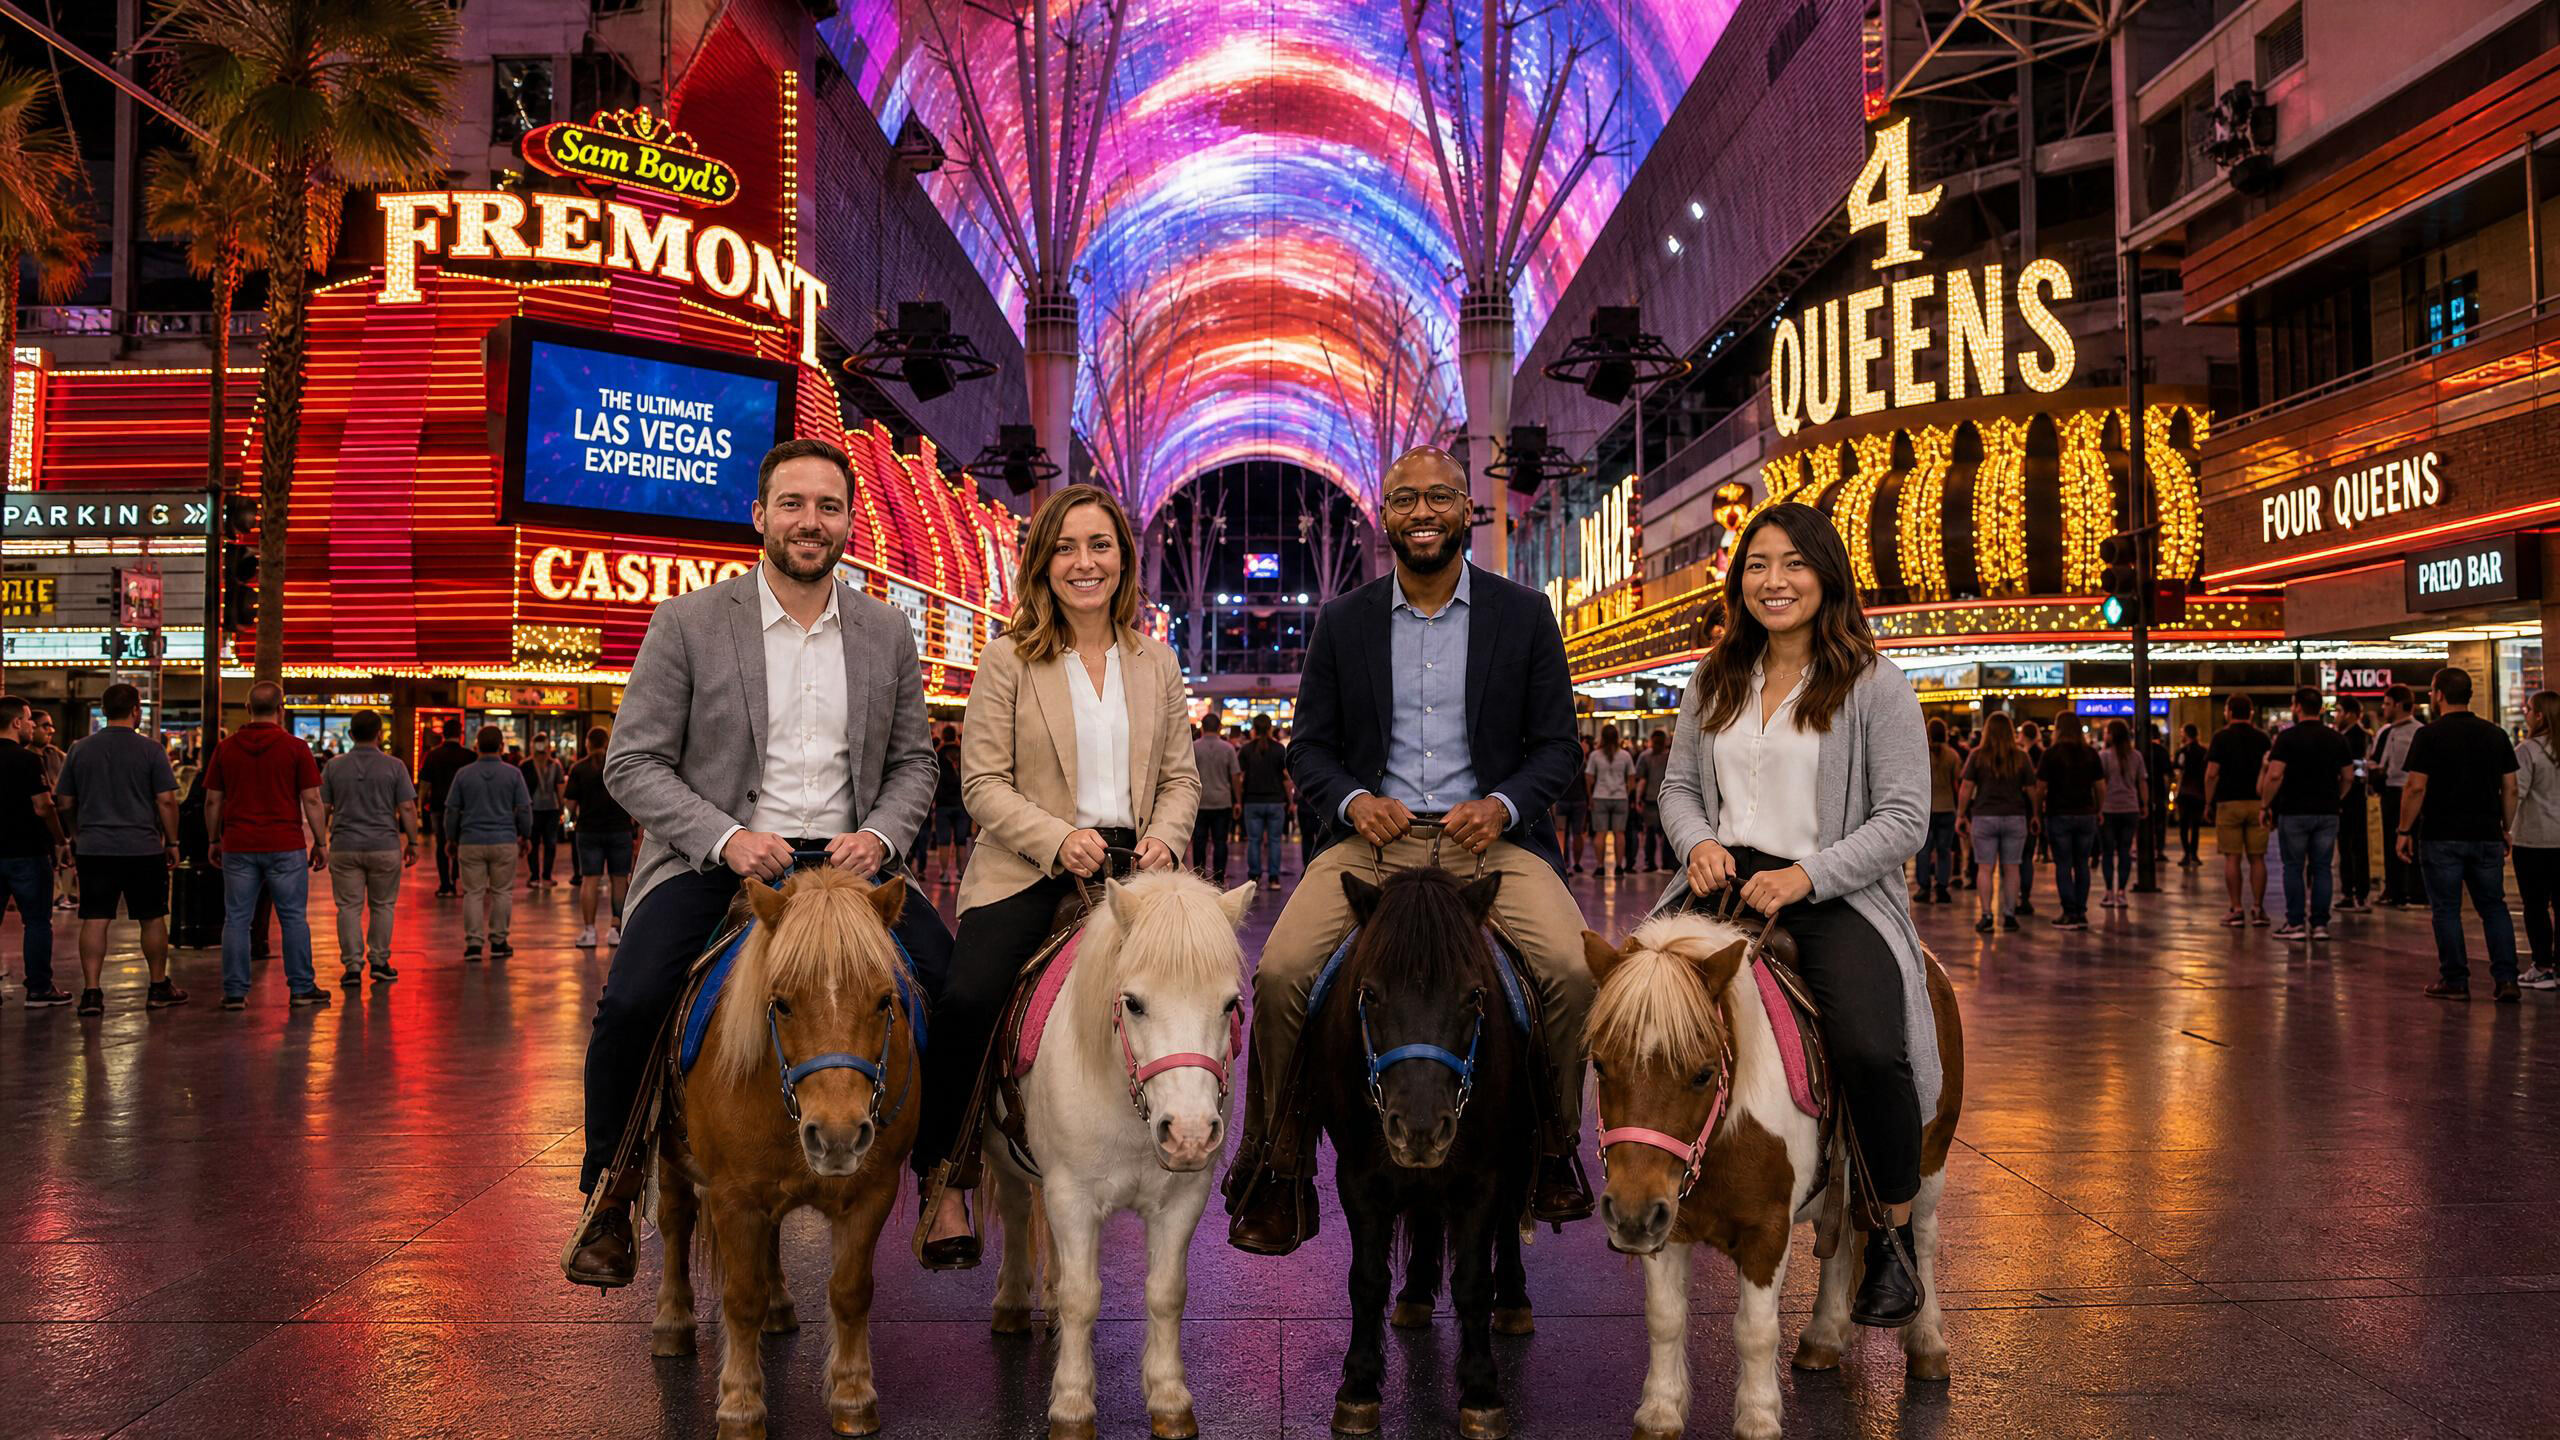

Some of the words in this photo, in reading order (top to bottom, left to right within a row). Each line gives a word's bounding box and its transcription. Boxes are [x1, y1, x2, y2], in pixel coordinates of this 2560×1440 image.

[557, 129, 630, 173] Sam
[635, 145, 729, 198] Boyd's
[1846, 116, 1944, 271] 4
[376, 190, 829, 370] FREMONT
[1771, 258, 2076, 438] QUEENS
[574, 408, 630, 445] LAS
[640, 417, 732, 459] VEGAS
[598, 388, 632, 411] THE
[637, 394, 714, 423] ULTIMATE
[585, 447, 718, 485] EXPERIENCE
[3, 504, 170, 526] PARKING
[2262, 484, 2322, 543] FOUR
[2334, 451, 2440, 529] QUEENS
[2467, 550, 2504, 588] BAR
